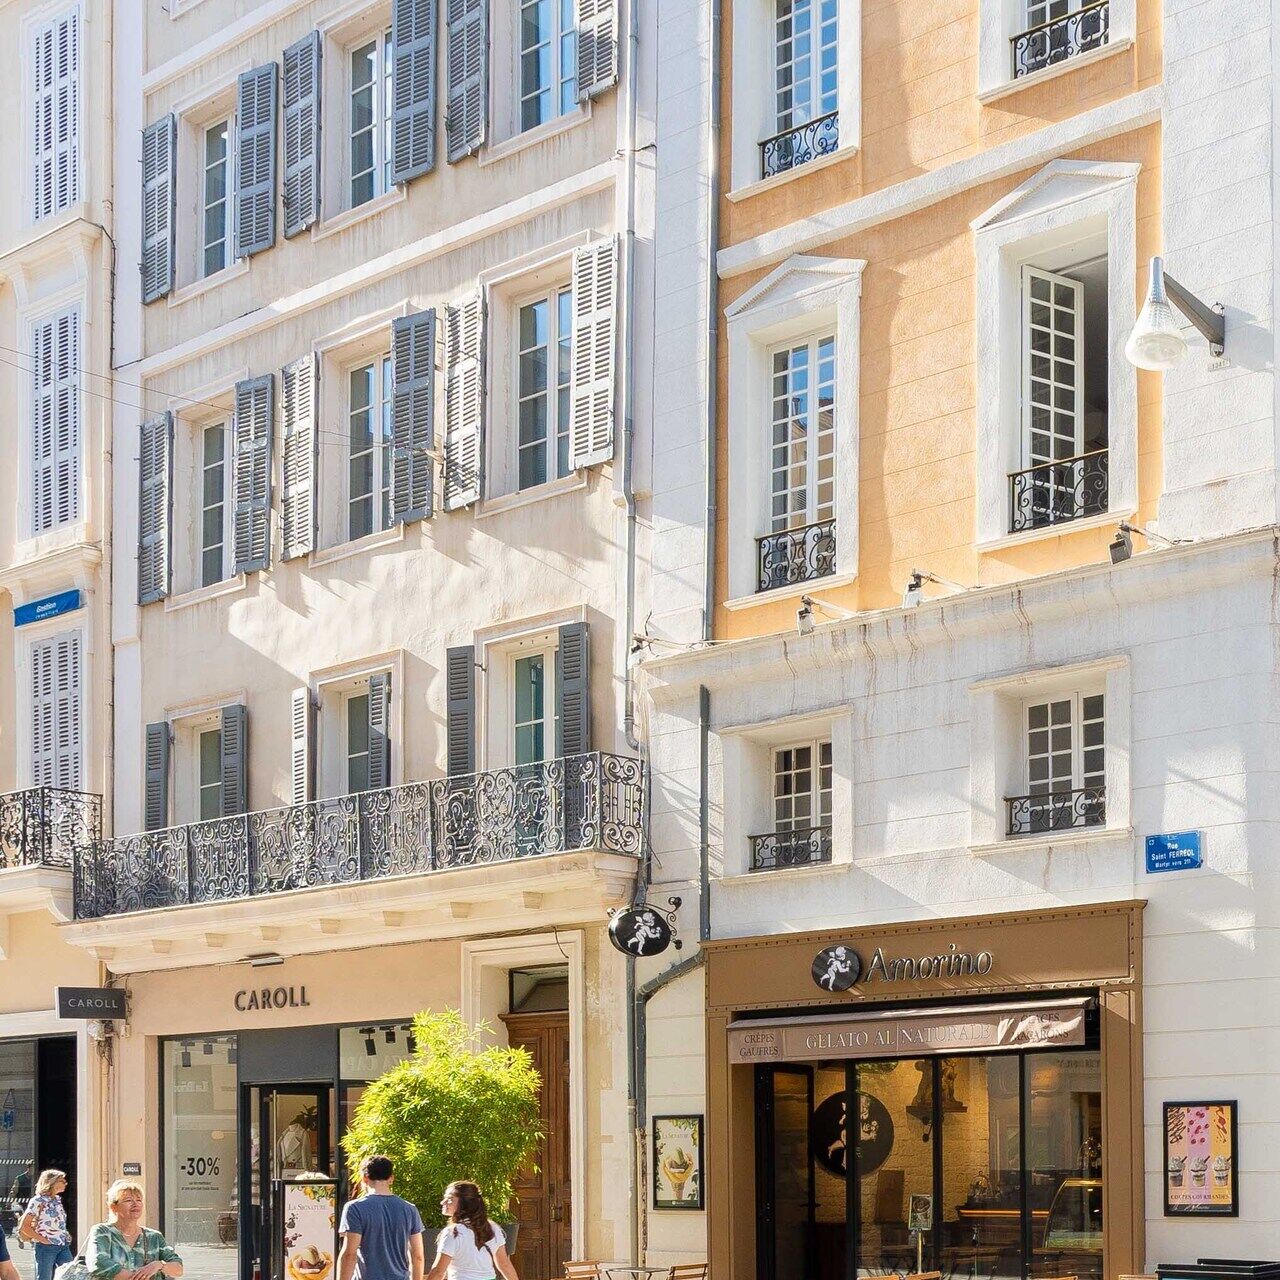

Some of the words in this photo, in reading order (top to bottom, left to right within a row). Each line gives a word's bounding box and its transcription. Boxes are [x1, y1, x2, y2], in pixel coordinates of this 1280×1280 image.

[1167, 842, 1179, 850] Rue
[1151, 853, 1167, 861] Saint
[863, 943, 993, 984] Amorino
[68, 998, 119, 1009] CAROLL
[233, 985, 311, 1012] CAROLL
[806, 1031, 868, 1049] GELATO
[874, 1029, 895, 1046] AL
[901, 1023, 991, 1044] NATURALE
[739, 1047, 779, 1057] GAUFRES
